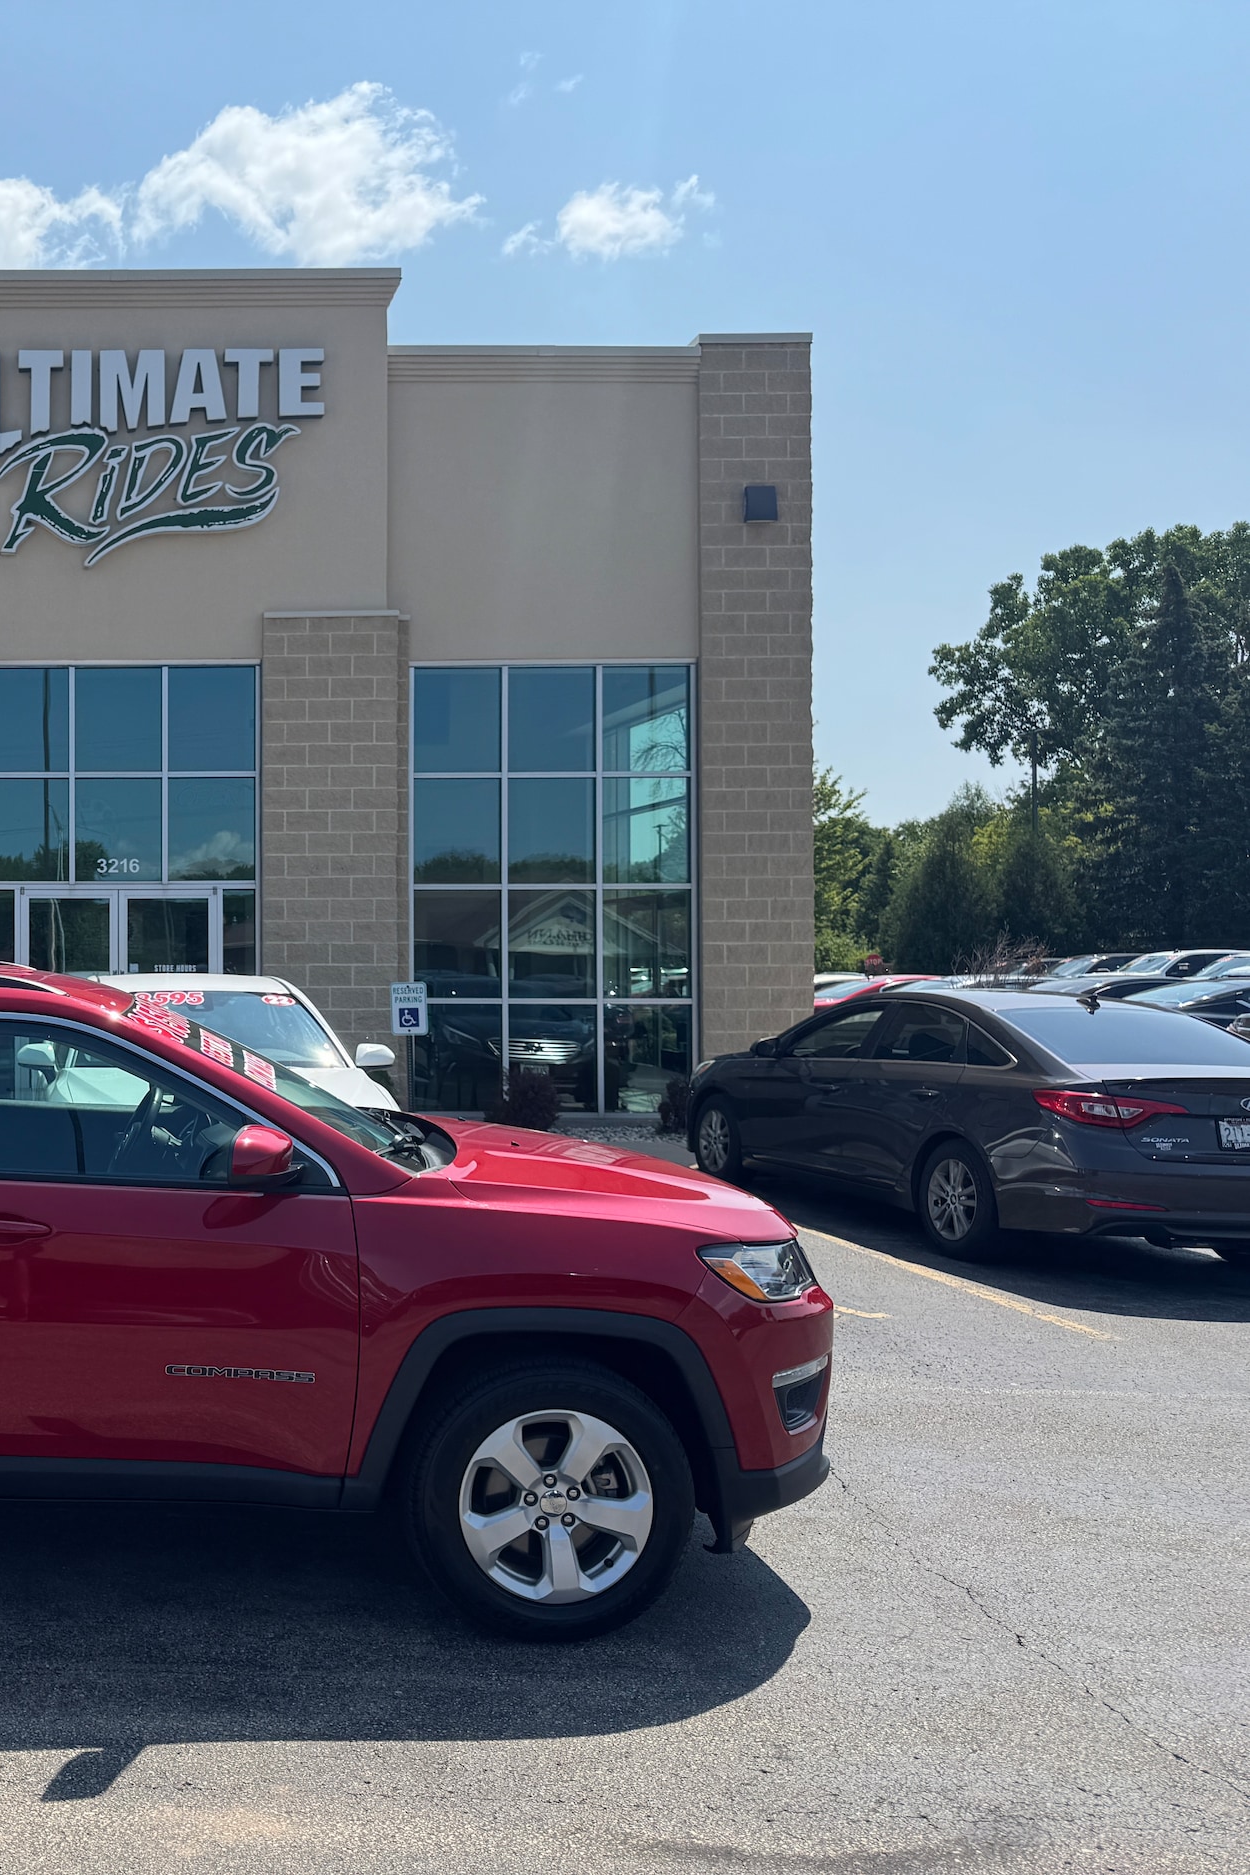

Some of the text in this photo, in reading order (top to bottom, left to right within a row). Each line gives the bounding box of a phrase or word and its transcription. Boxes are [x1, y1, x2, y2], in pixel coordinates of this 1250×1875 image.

[96, 858, 140, 873] 3216
[154, 964, 197, 972] STORE HOURS
[393, 986, 424, 995] RESERVED
[165, 1364, 316, 1384] COMPASS
